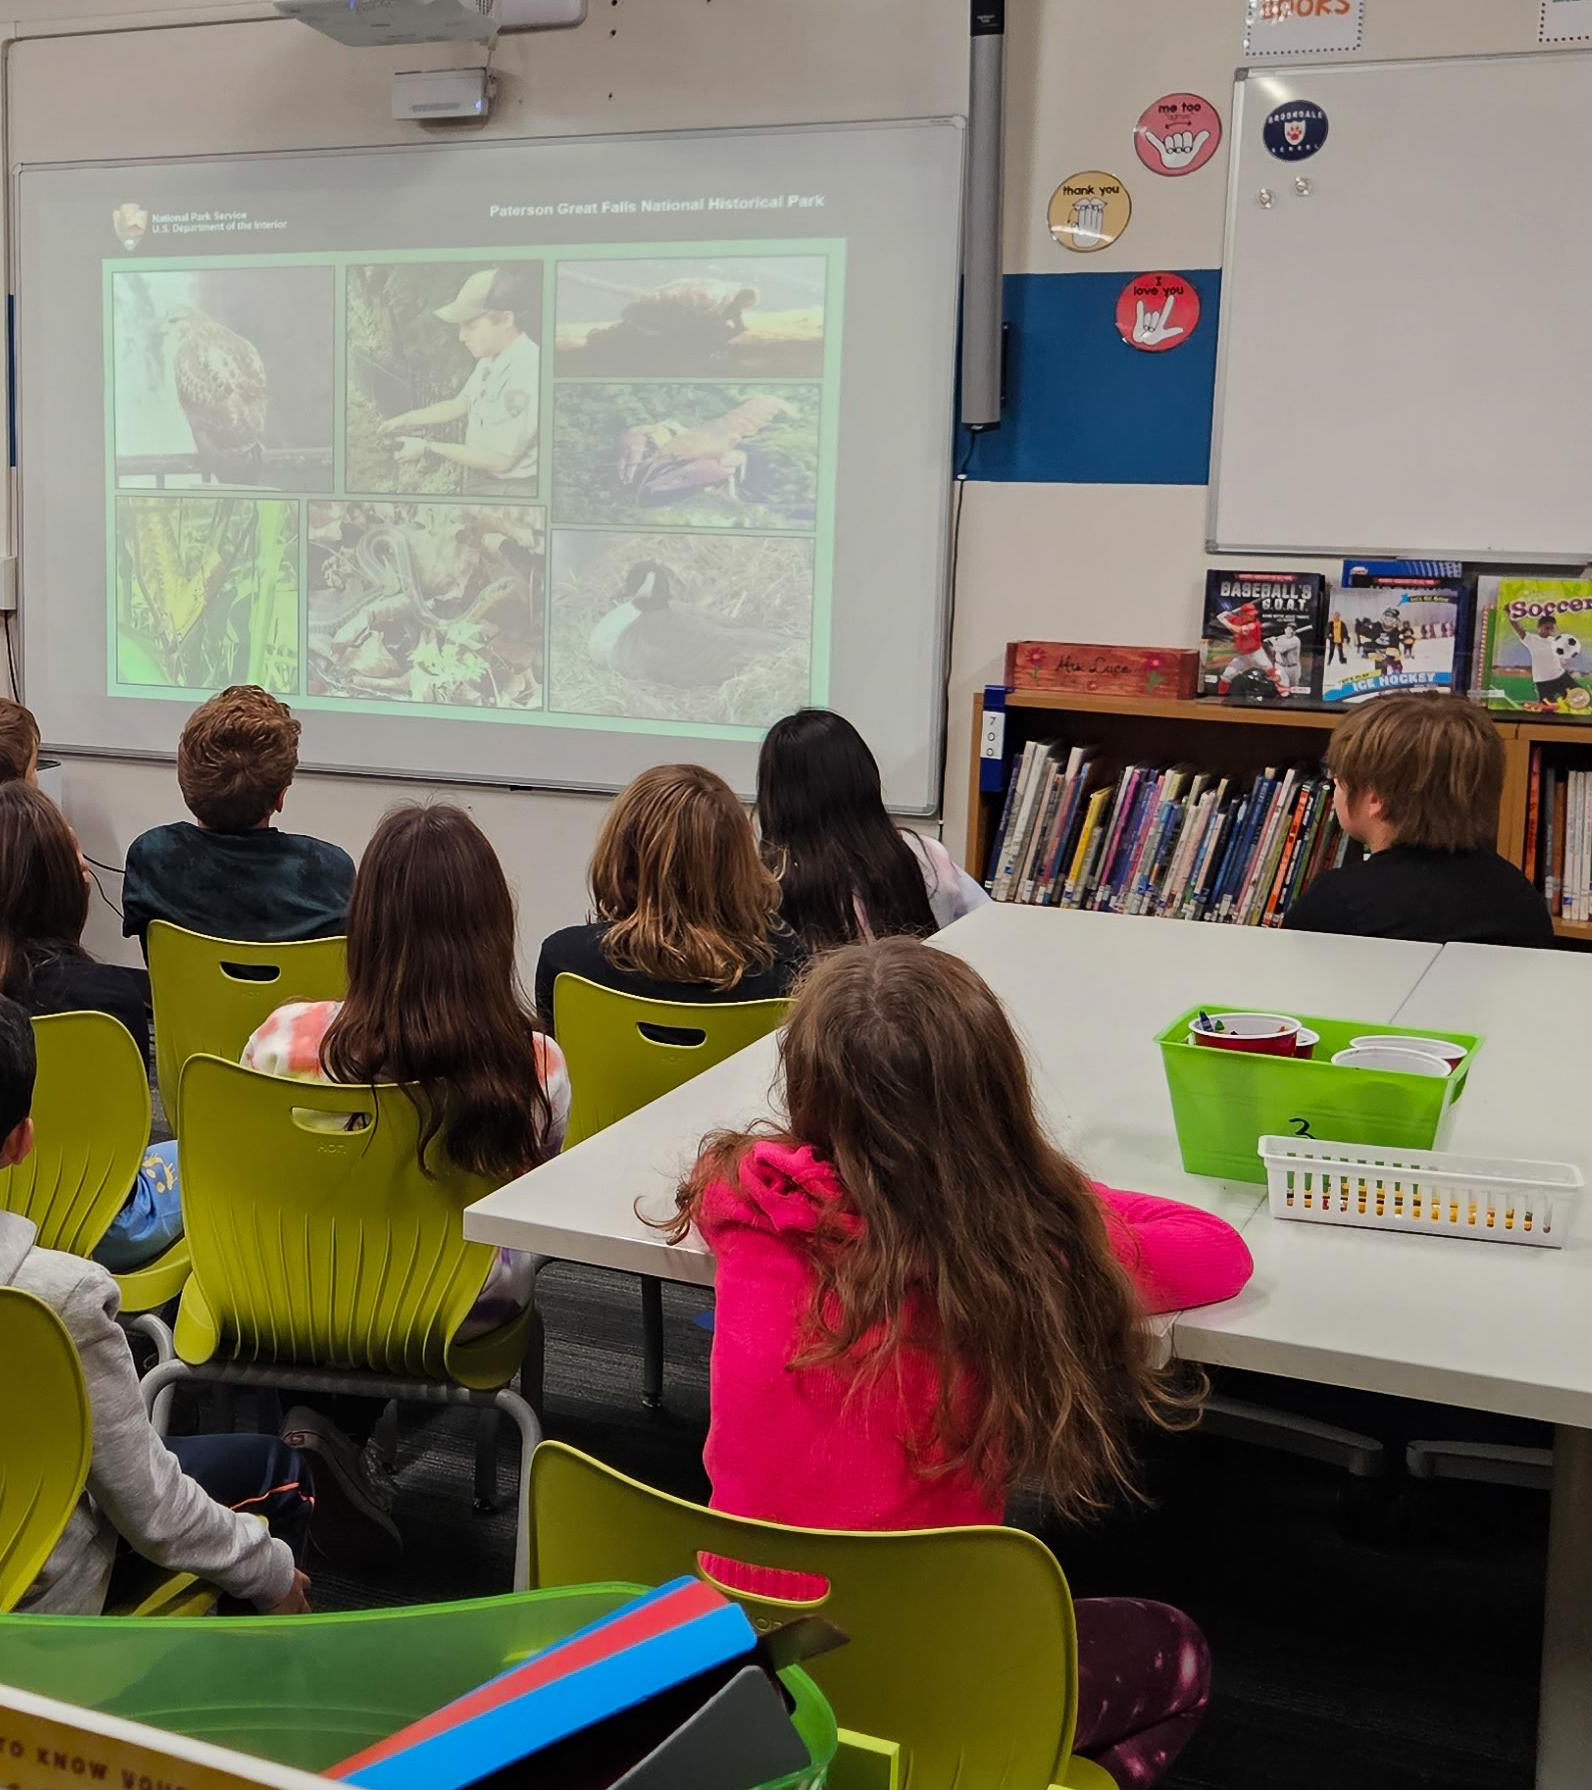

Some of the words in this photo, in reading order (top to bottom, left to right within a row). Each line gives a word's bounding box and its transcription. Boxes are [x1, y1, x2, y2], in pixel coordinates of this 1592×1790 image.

[1158, 103, 1177, 113] me
[1180, 102, 1201, 112] too
[1062, 185, 1094, 196] thank
[1099, 186, 1119, 197] you
[489, 203, 553, 217] Paterson
[557, 202, 598, 216] Great
[602, 200, 637, 214] Falls
[641, 198, 704, 212] National
[708, 195, 783, 211] Historical
[787, 194, 824, 208] Park
[152, 212, 189, 223] National
[191, 211, 210, 222] Park
[213, 211, 247, 221] Service
[152, 223, 170, 234] U.S.
[173, 222, 225, 234] Department
[226, 221, 236, 231] of
[237, 221, 252, 230] the
[254, 220, 288, 230] Interior
[1156, 276, 1162, 286] I
[1133, 286, 1158, 296] love
[1163, 286, 1184, 298] you
[1220, 581, 1312, 600] BASEBALL'S
[1352, 677, 1376, 692] ICE
[1379, 672, 1436, 687] HOCKEY
[37, 1746, 109, 1781] KNOW
